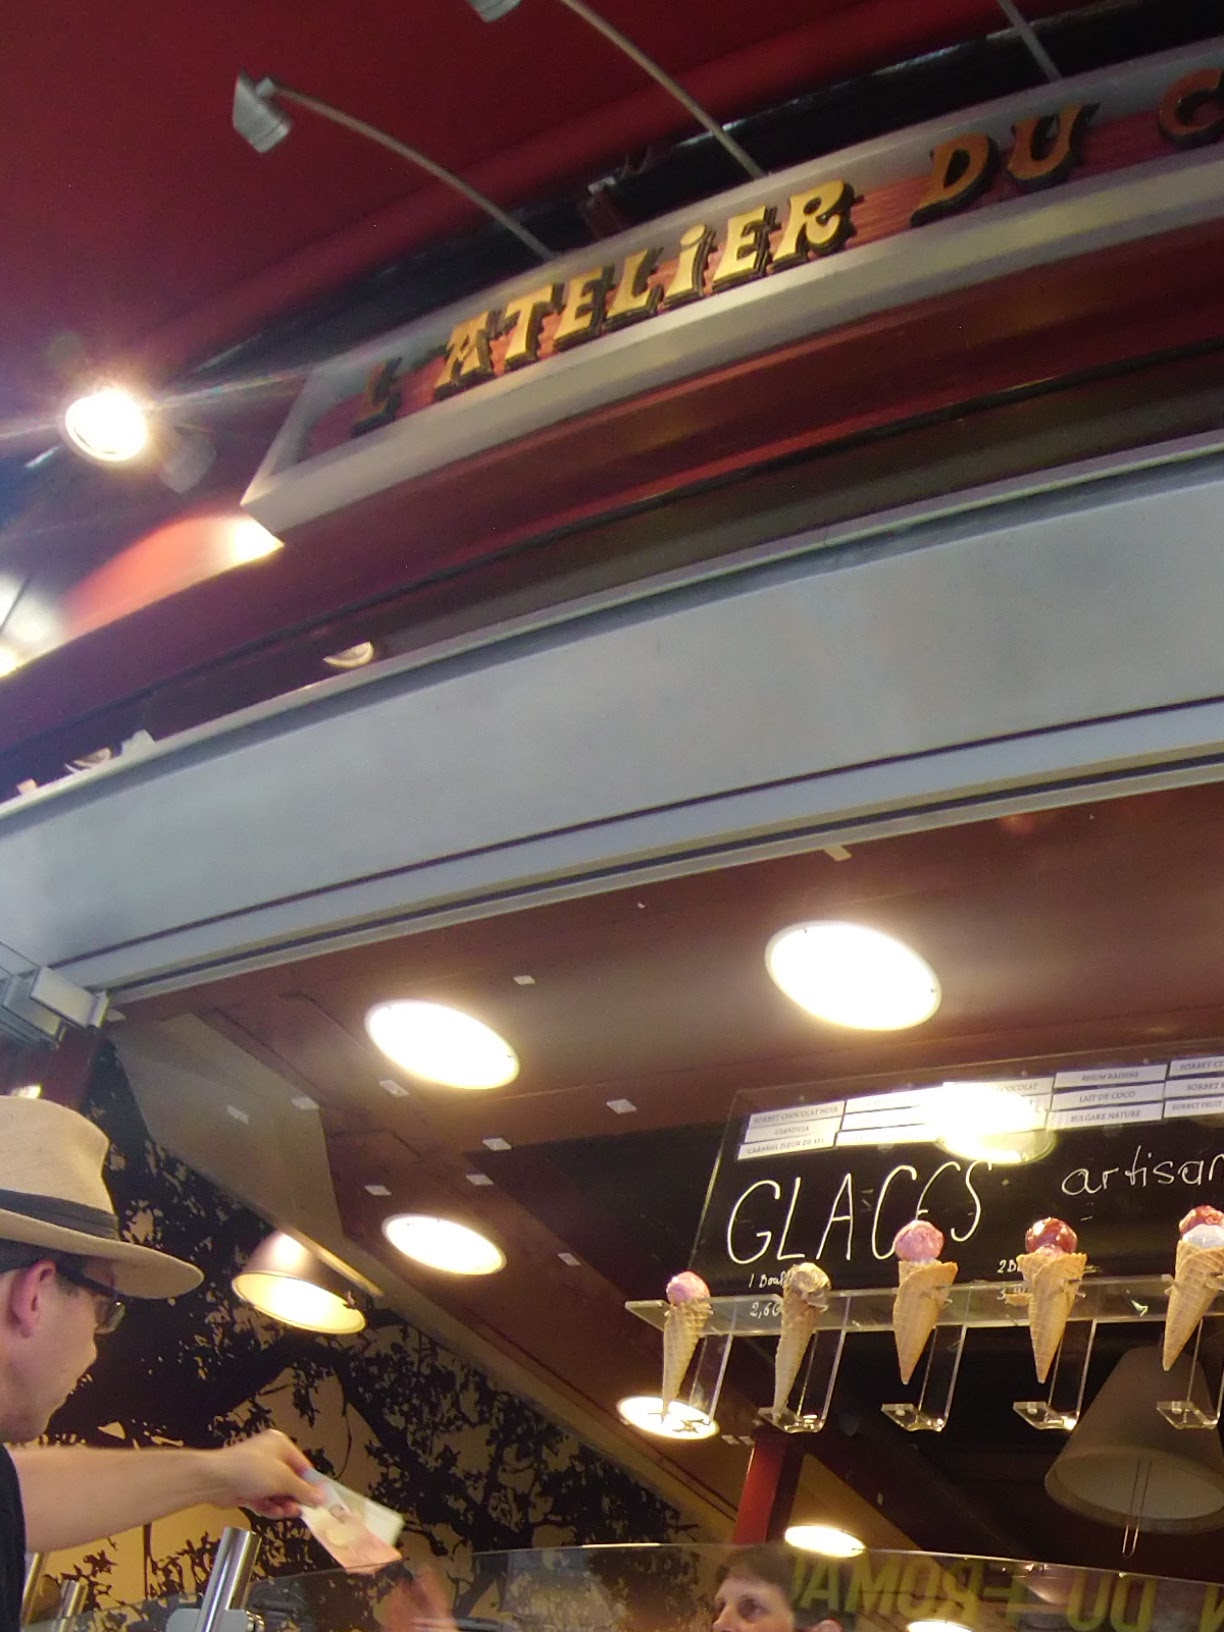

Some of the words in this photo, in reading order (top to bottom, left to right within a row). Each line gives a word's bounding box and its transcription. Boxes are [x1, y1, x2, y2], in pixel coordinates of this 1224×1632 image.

[910, 103, 1100, 228] DU
[1179, 1061, 1212, 1071] SORBET
[1081, 1072, 1107, 1082] RHUM
[1108, 1071, 1139, 1080] RAISINS
[1187, 1081, 1220, 1092] SORBET
[1079, 1092, 1097, 1103] LAIT
[1098, 1092, 1110, 1101] DE
[1111, 1090, 1135, 1099] COCO
[1172, 1102, 1199, 1111] SORBET
[1200, 1100, 1222, 1109] FRUIT
[1071, 1112, 1106, 1122] BULGARE
[1107, 1109, 1141, 1120] NATURE
[726, 1160, 993, 1264] GLACES
[996, 1259, 1007, 1274] 2
